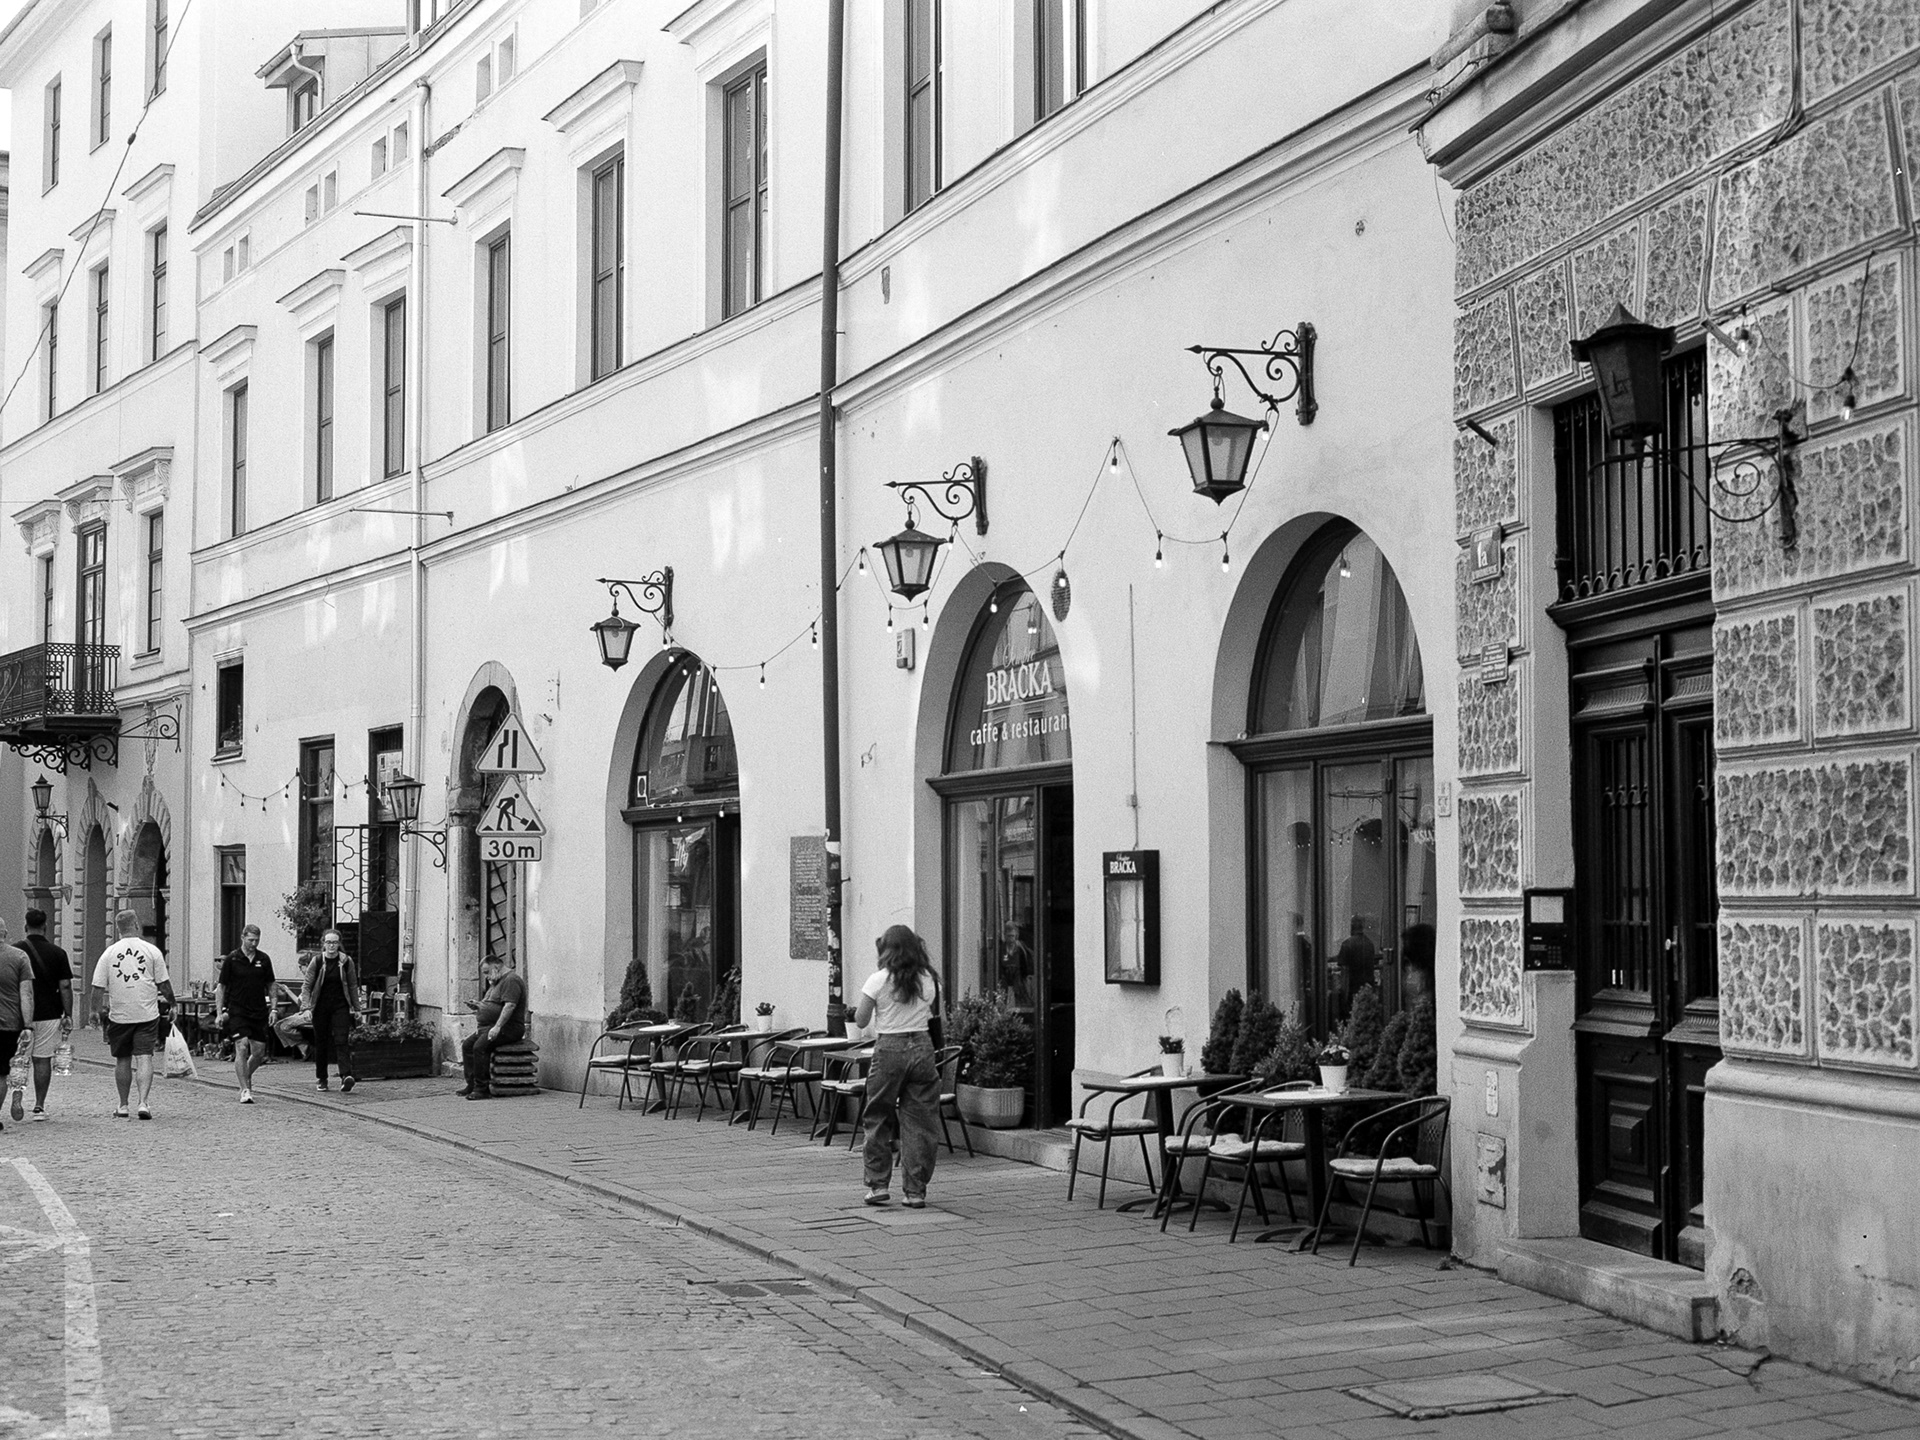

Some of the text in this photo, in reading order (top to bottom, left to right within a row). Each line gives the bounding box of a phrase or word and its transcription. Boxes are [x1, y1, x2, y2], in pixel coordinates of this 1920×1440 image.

[986, 660, 1053, 706] BRACKA
[1001, 722, 1009, 741] &
[1011, 713, 1068, 739] restauran
[1109, 860, 1137, 874] BRACKA
